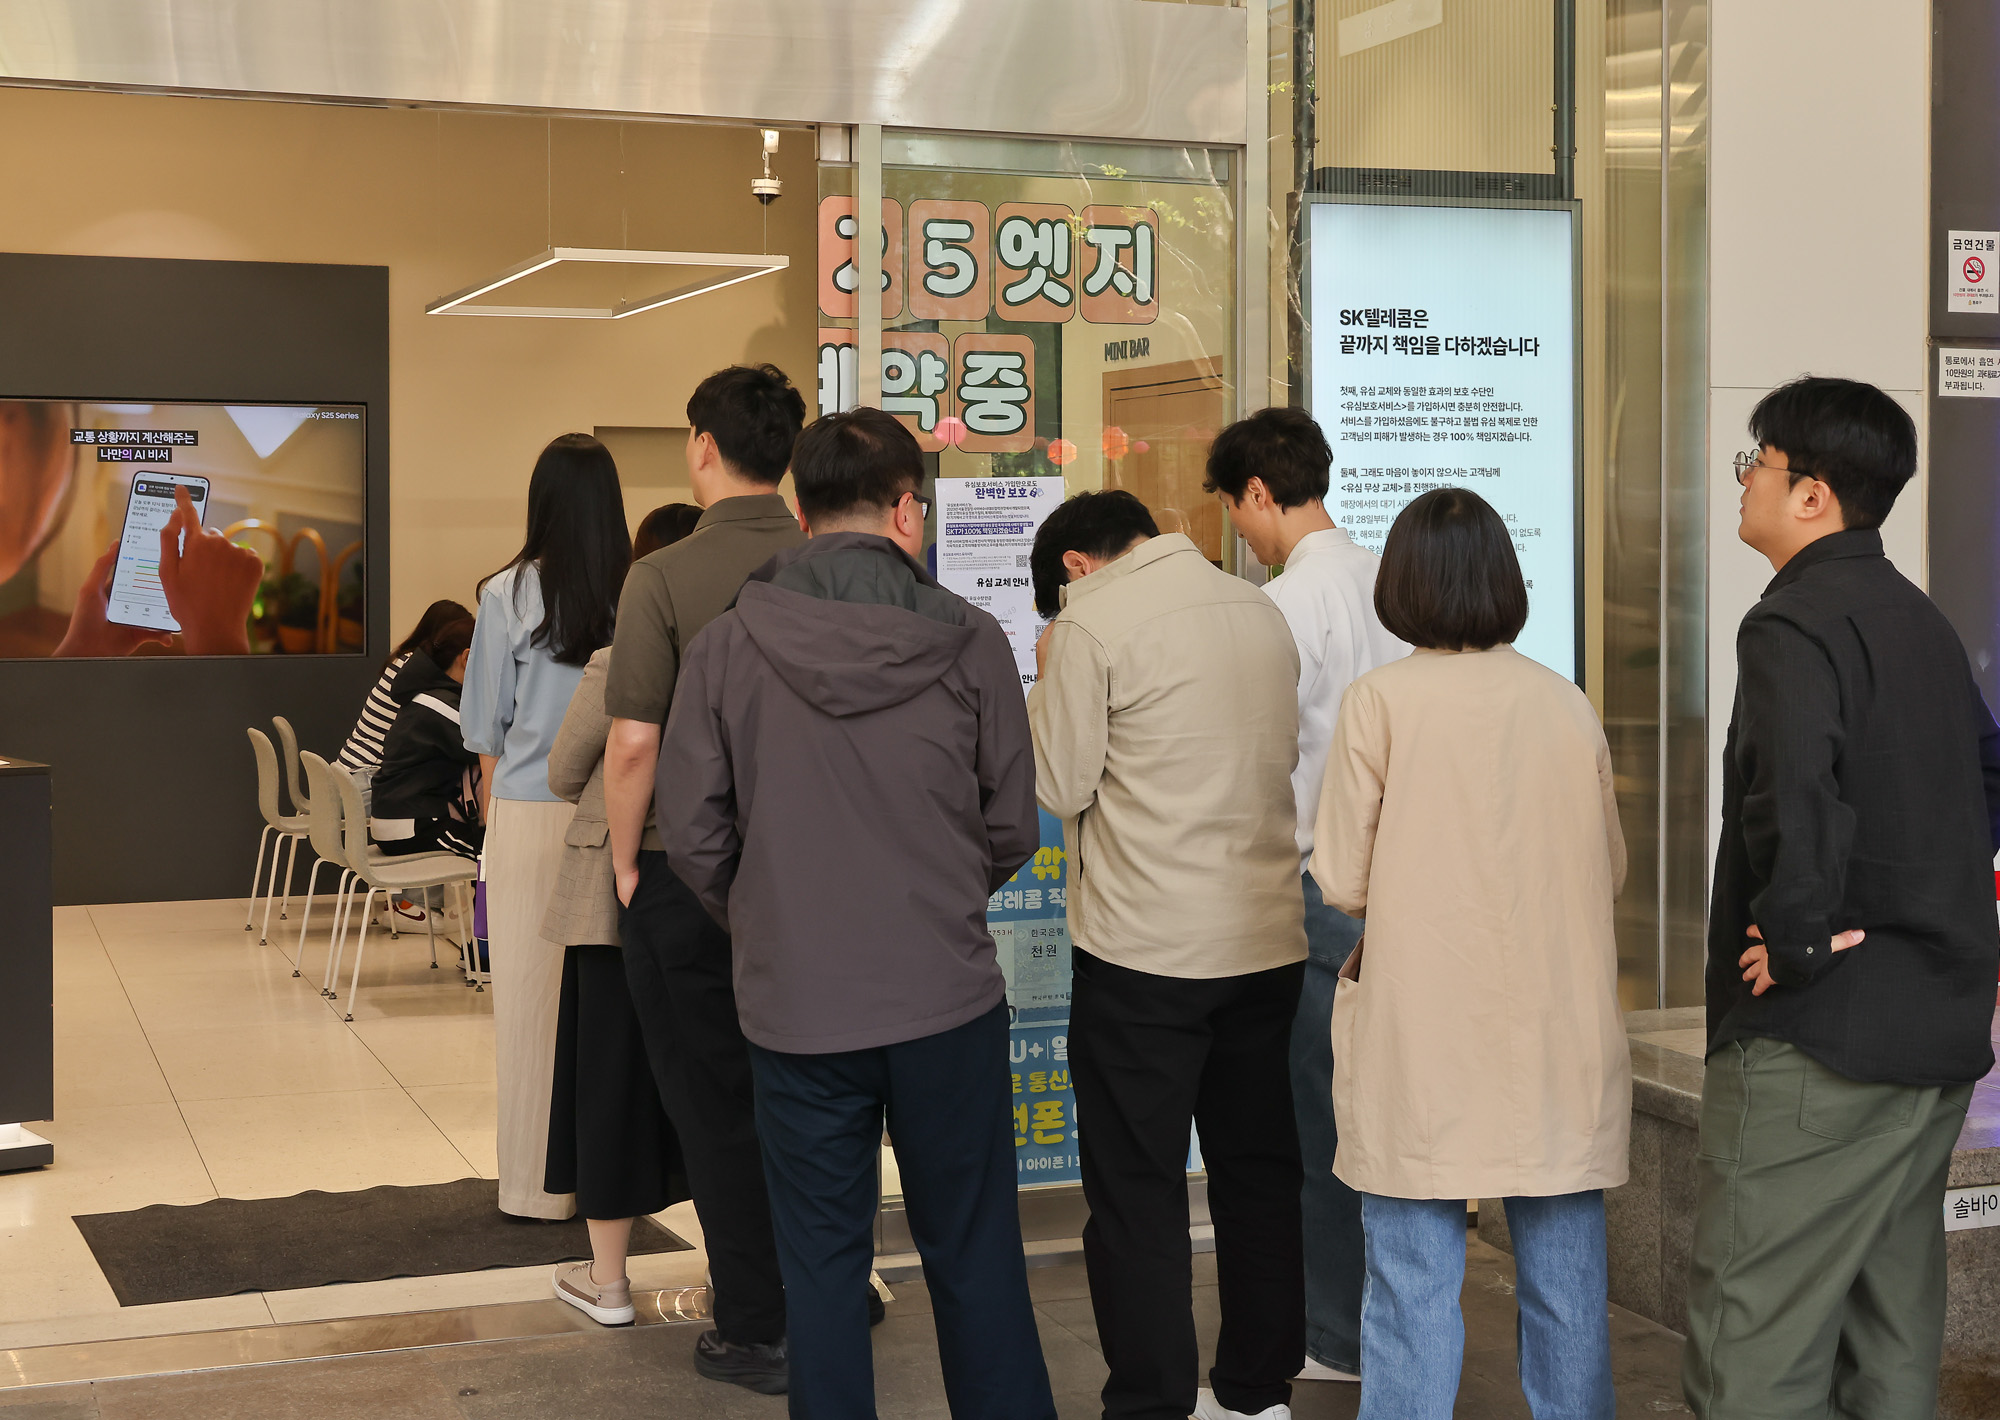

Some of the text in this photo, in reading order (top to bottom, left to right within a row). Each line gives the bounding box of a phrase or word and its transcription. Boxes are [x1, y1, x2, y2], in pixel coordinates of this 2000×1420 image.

[1953, 238, 1995, 251] 금연건물
[1340, 308, 1429, 329] SK텔레콤은
[1104, 337, 1150, 362] MINI BAR
[1340, 335, 1540, 357] 끝까지 책임을 다하겠습니다
[1945, 356, 1975, 366] 통로에서
[1979, 357, 1994, 366] 흡연
[1946, 368, 1974, 378] 10만원의
[1340, 386, 1494, 397] 첫째, 유심 교체와 동일한 효과의 보호 수단인
[1945, 381, 1985, 391] 부과됩니다.
[1340, 401, 1523, 412] <유심보호서비스>를 가입하시면 충분히 안전합니다.
[336, 412, 359, 420] Series
[1340, 416, 1538, 426] 서비스를 가입하셨음에도 불구하고 불법 유심 복제로 인한
[74, 431, 194, 444] 교통 상황까지 계산해주는
[1340, 432, 1532, 442] 고객님의 피해가 발생하는 경우 100% 책임지겠습니다.
[100, 448, 168, 461] 나만의 AI 비서
[1340, 468, 1500, 478] 둘째, 그래도 마음이 놓이지 않으시는 고객님께
[975, 488, 1028, 499] 완벽한 보호
[1341, 483, 1362, 492] <유심
[1364, 483, 1380, 492] 무상
[1382, 483, 1412, 493] 교체>를
[1340, 499, 1378, 509] 매장에서의
[1380, 499, 1395, 509] 대기
[1340, 514, 1354, 524] 4월
[1356, 514, 1388, 524] 28일부터
[946, 528, 964, 536] SKT가
[1360, 530, 1382, 539] 해외로
[1519, 528, 1542, 538] 없도록
[976, 578, 1029, 588] 유심 교체 안내
[1031, 927, 1064, 938] 한국은행
[1028, 1069, 1074, 1093] 통신
[1026, 1156, 1064, 1171] 아이폰
